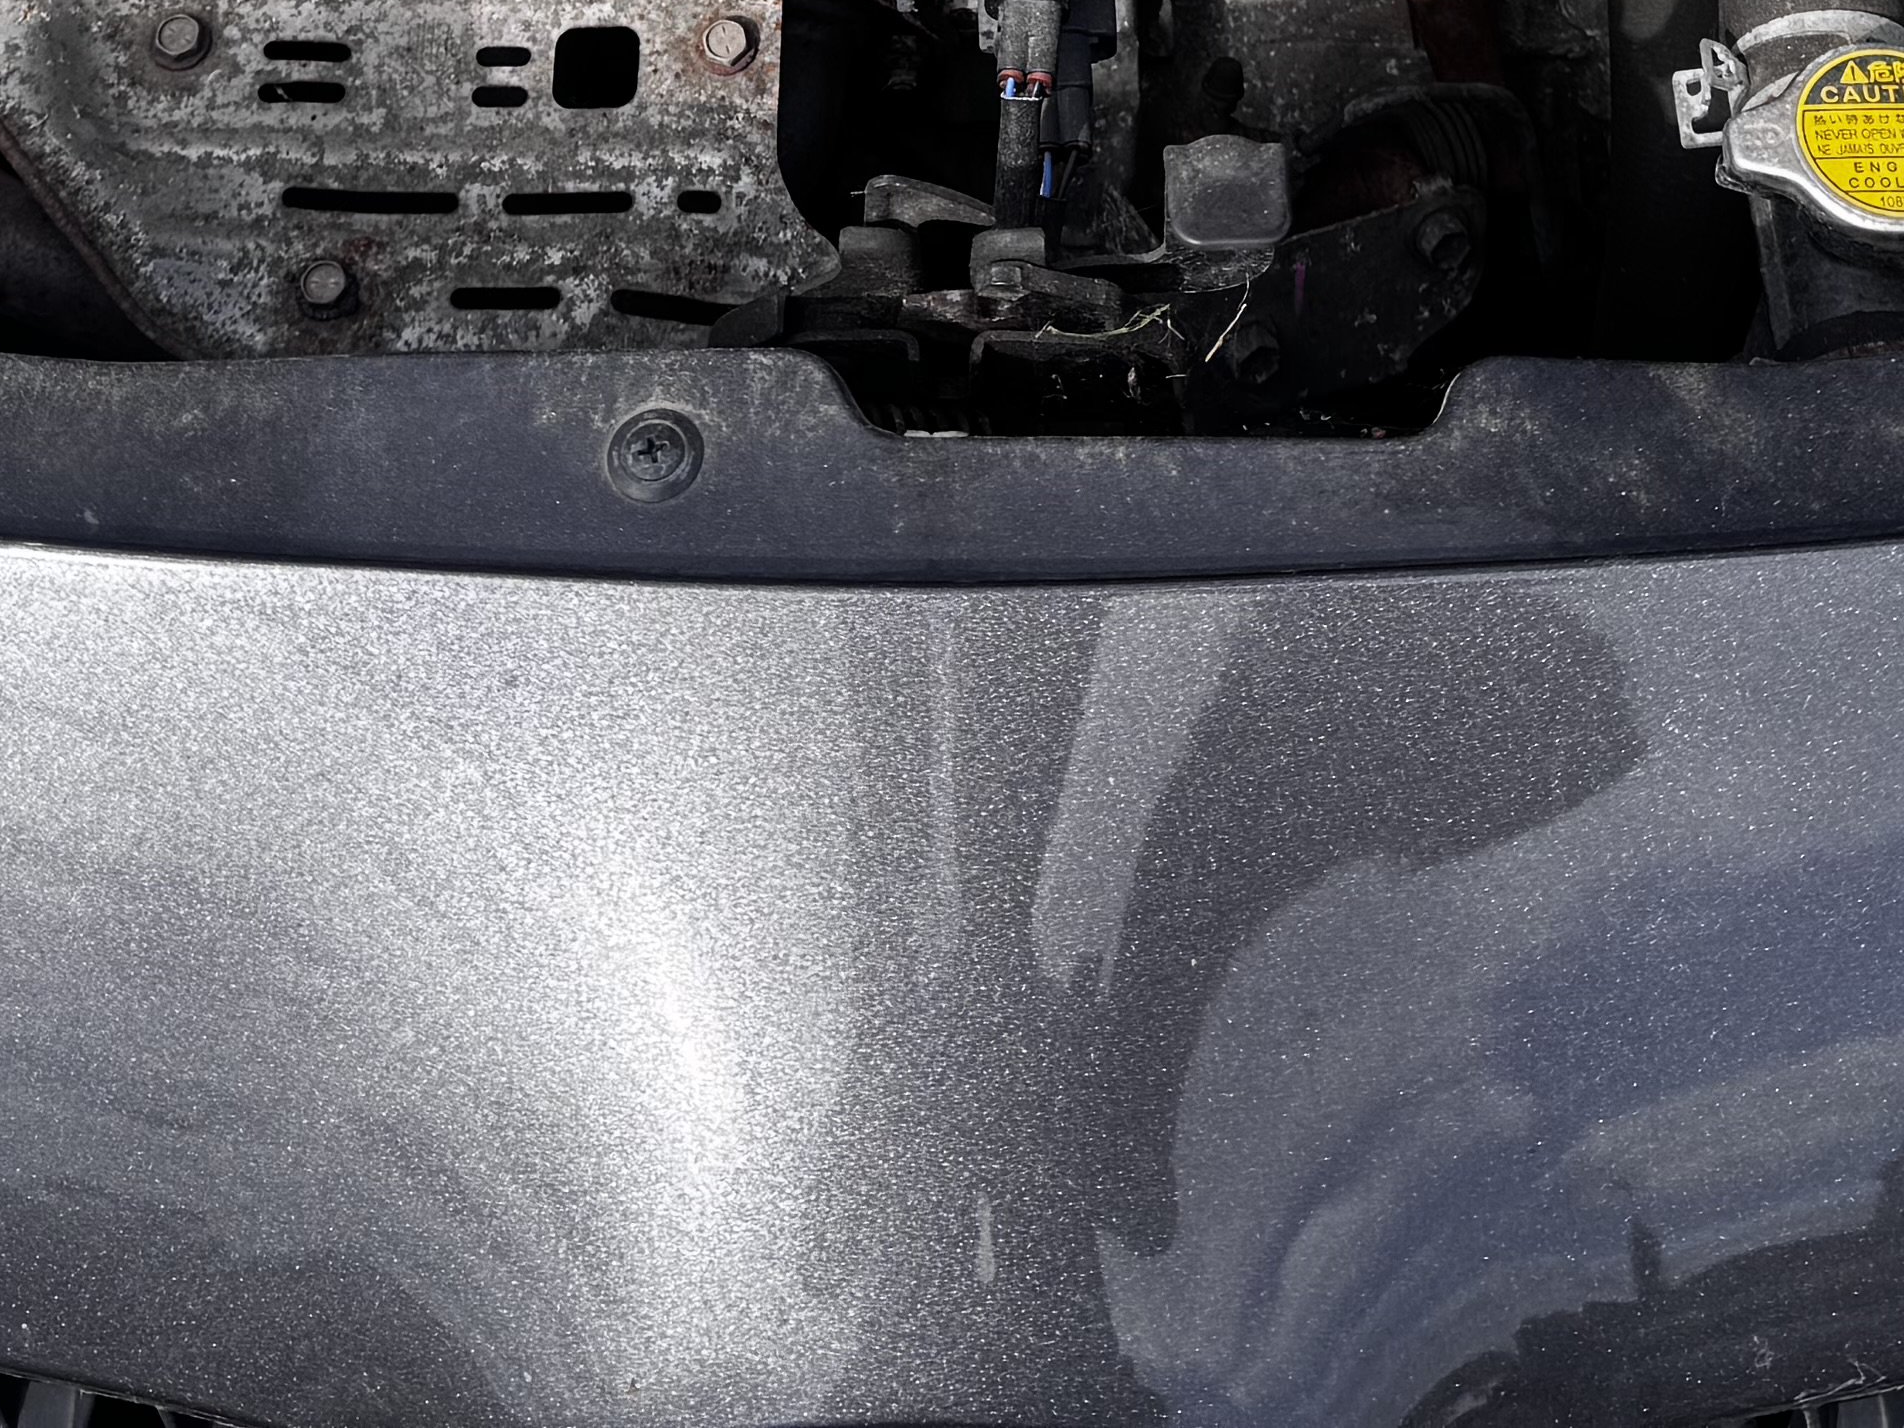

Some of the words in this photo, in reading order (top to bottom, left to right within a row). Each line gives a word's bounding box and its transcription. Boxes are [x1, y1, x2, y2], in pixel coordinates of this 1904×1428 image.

[1815, 128, 1857, 141] NEVER
[1861, 128, 1896, 140] OPEN
[1817, 144, 1830, 155] NE
[1837, 143, 1874, 155] JAMAIS
